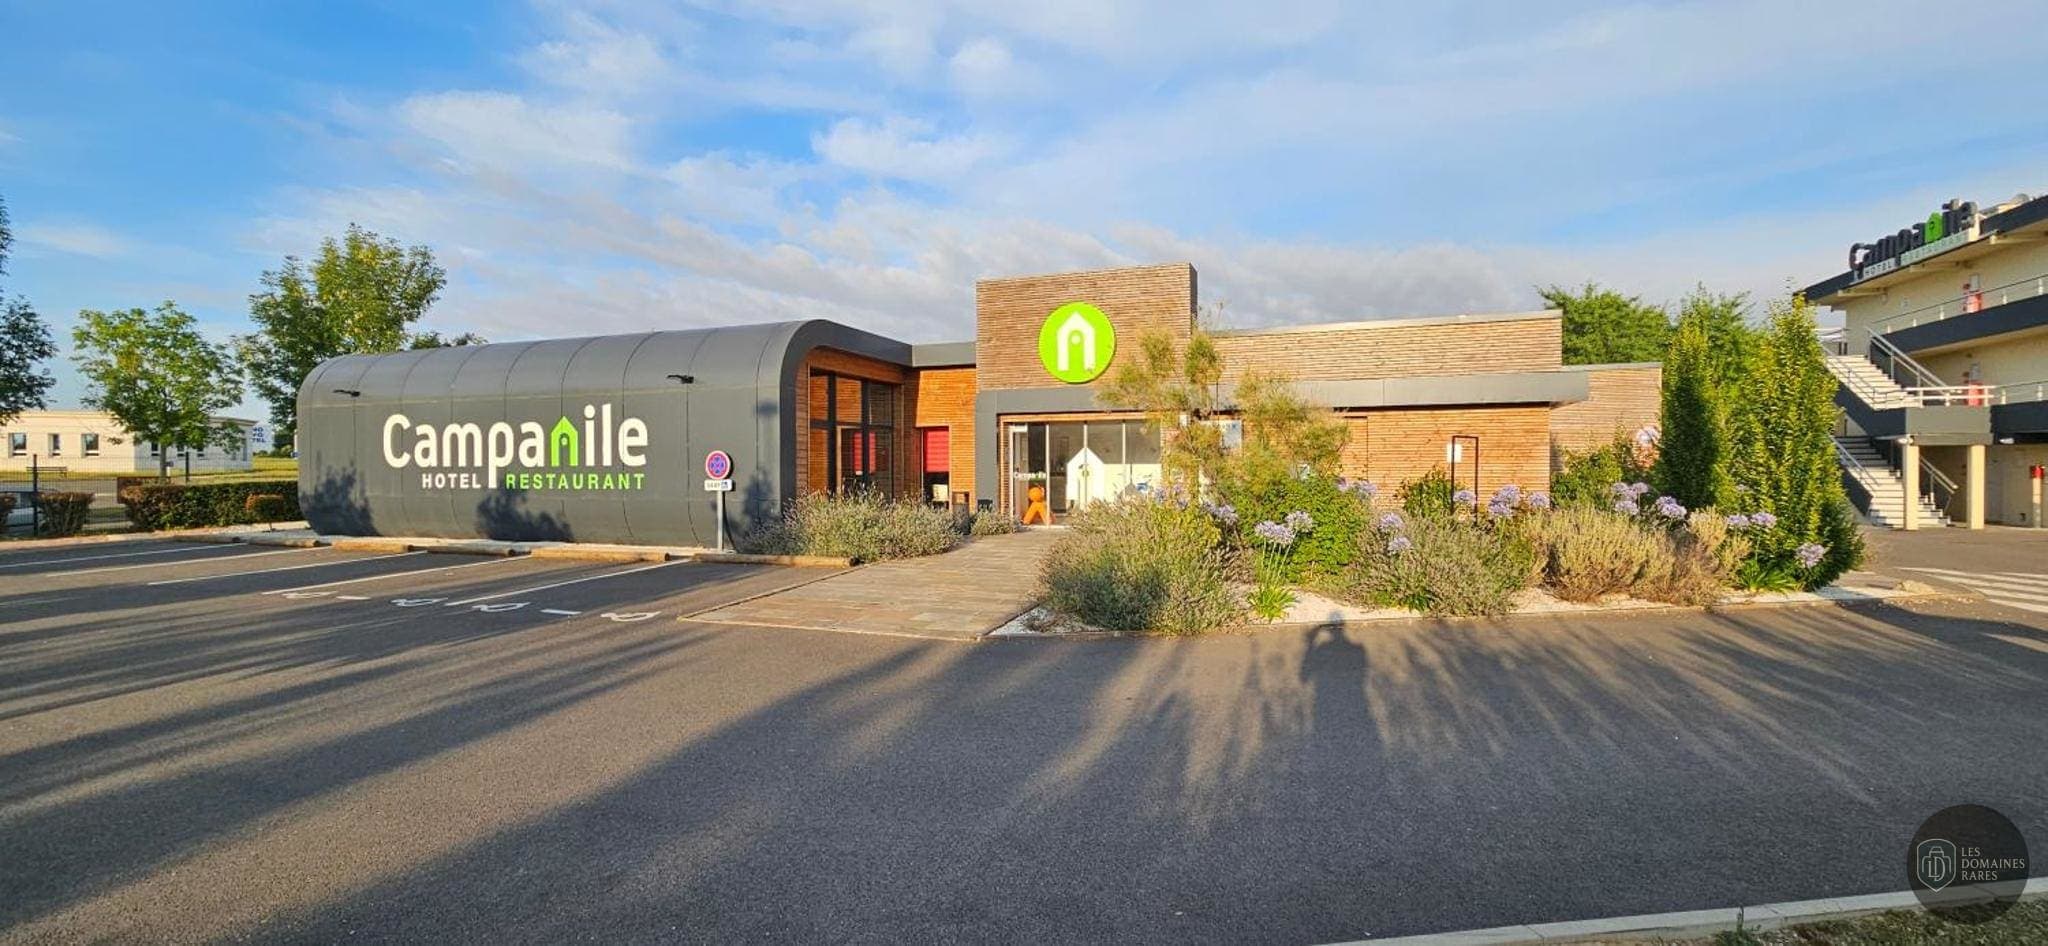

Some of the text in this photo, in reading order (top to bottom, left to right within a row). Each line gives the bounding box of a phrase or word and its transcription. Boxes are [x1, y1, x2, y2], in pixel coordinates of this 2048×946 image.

[383, 404, 648, 489] Campanile
[422, 473, 645, 490] HOTEL RESTAURANT
